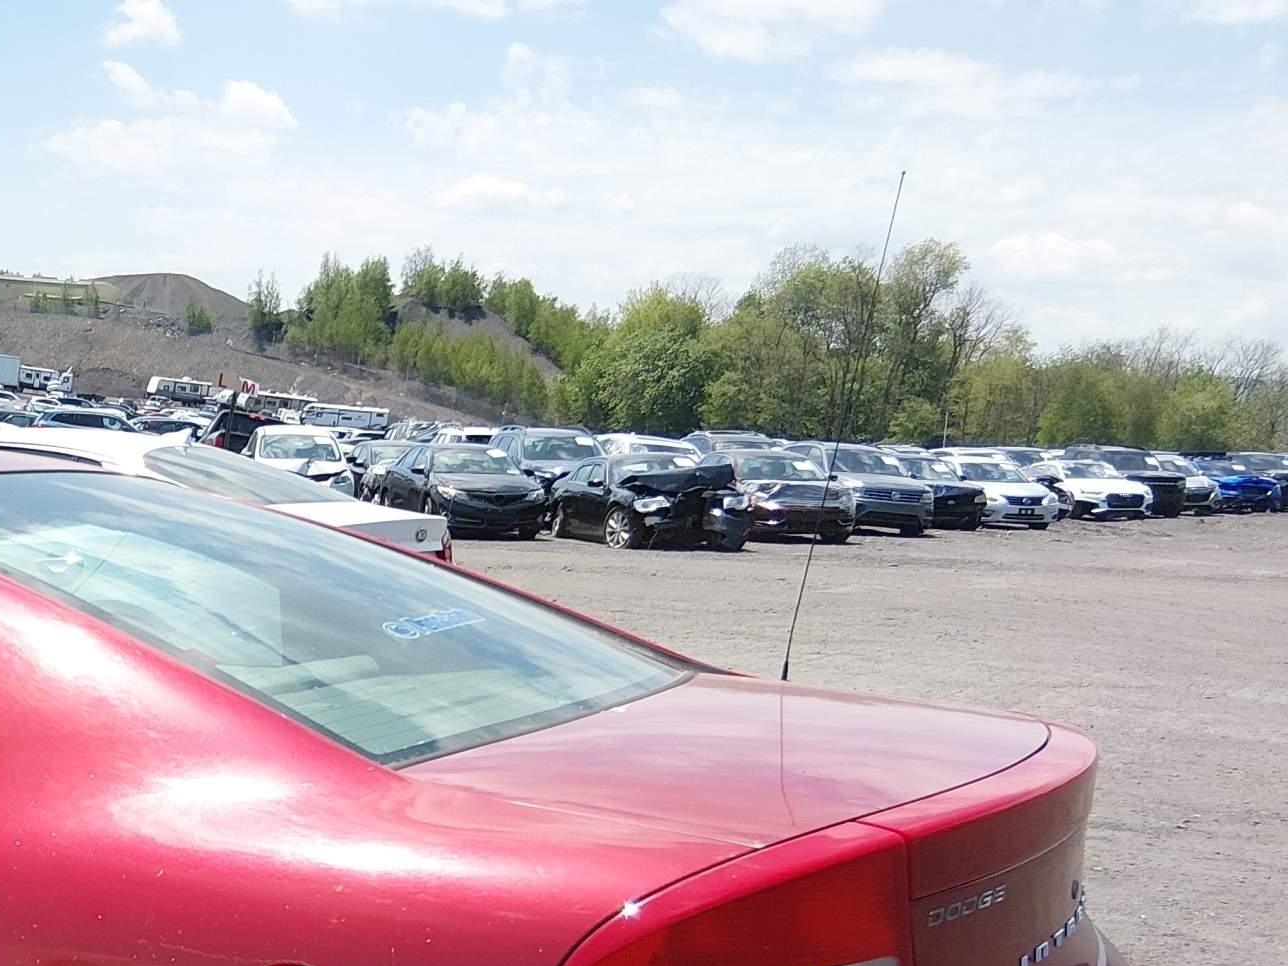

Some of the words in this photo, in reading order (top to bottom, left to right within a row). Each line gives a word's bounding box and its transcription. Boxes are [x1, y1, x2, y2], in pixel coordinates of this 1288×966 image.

[218, 372, 228, 389] L
[241, 380, 256, 395] M
[927, 884, 1007, 928] DODGE
